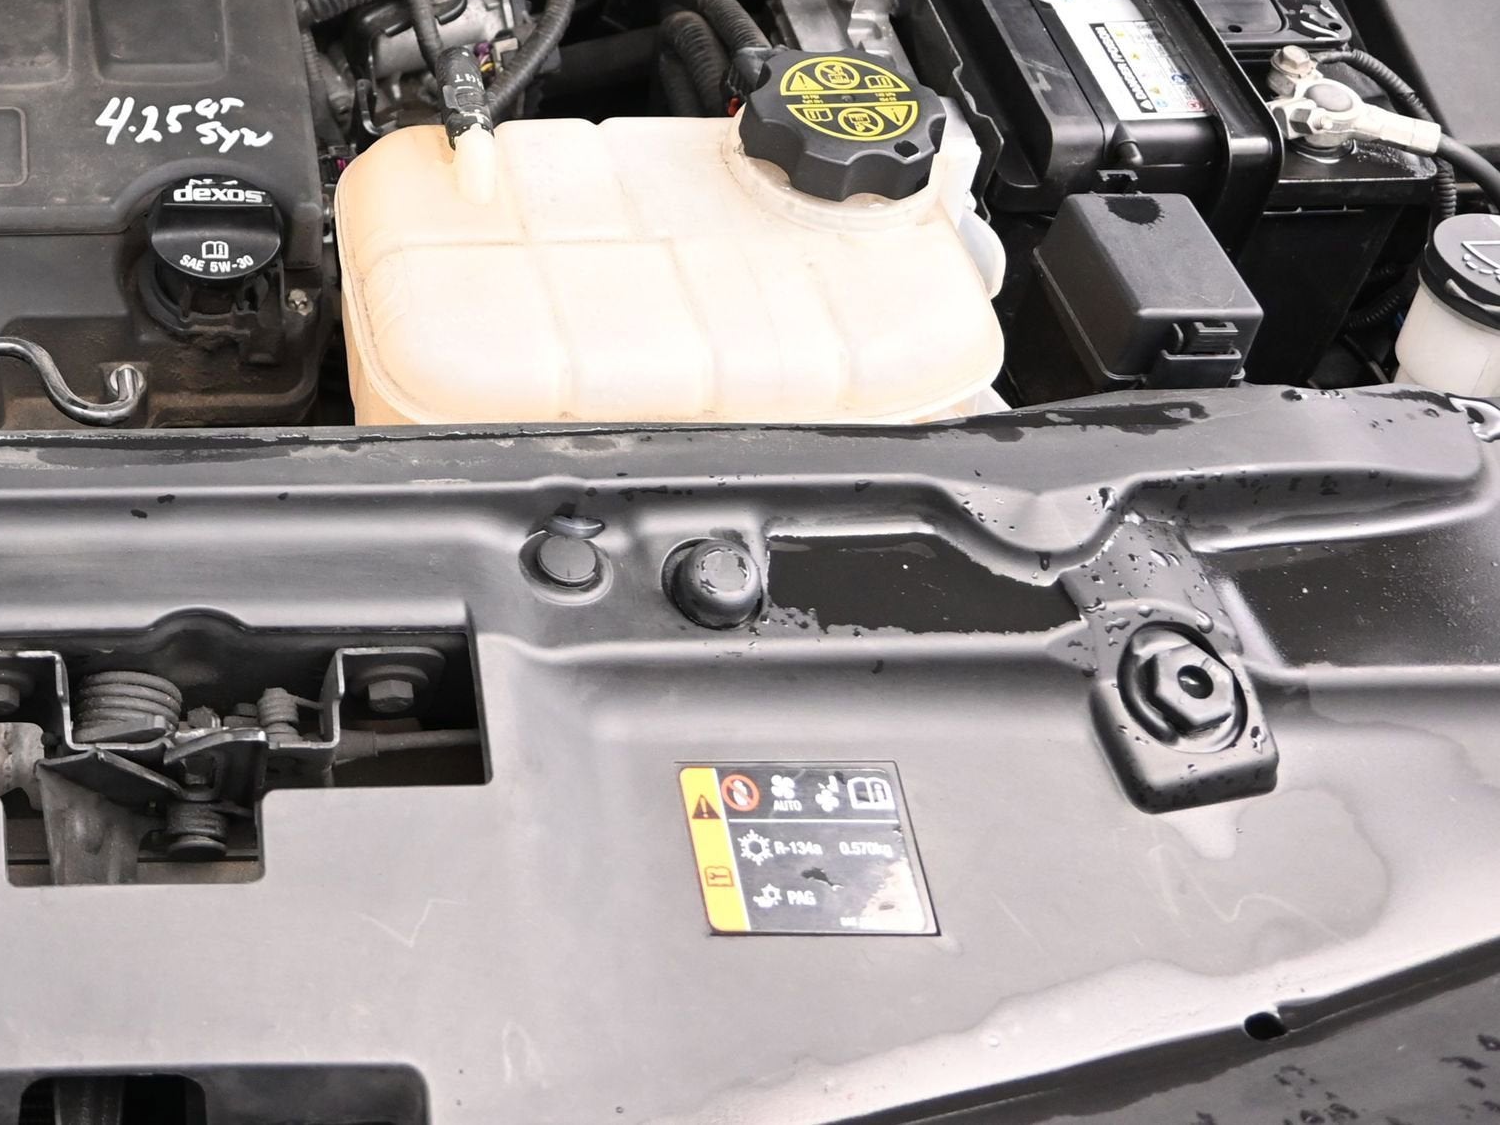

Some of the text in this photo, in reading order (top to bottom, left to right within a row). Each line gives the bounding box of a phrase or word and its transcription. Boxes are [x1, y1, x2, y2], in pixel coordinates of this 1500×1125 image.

[95, 96, 193, 145] 4.25
[173, 185, 266, 203] dexos
[180, 254, 254, 273] SAE 5W-30
[773, 800, 802, 811] AUTO
[773, 841, 823, 855] R-134a
[786, 890, 817, 905] PAG
